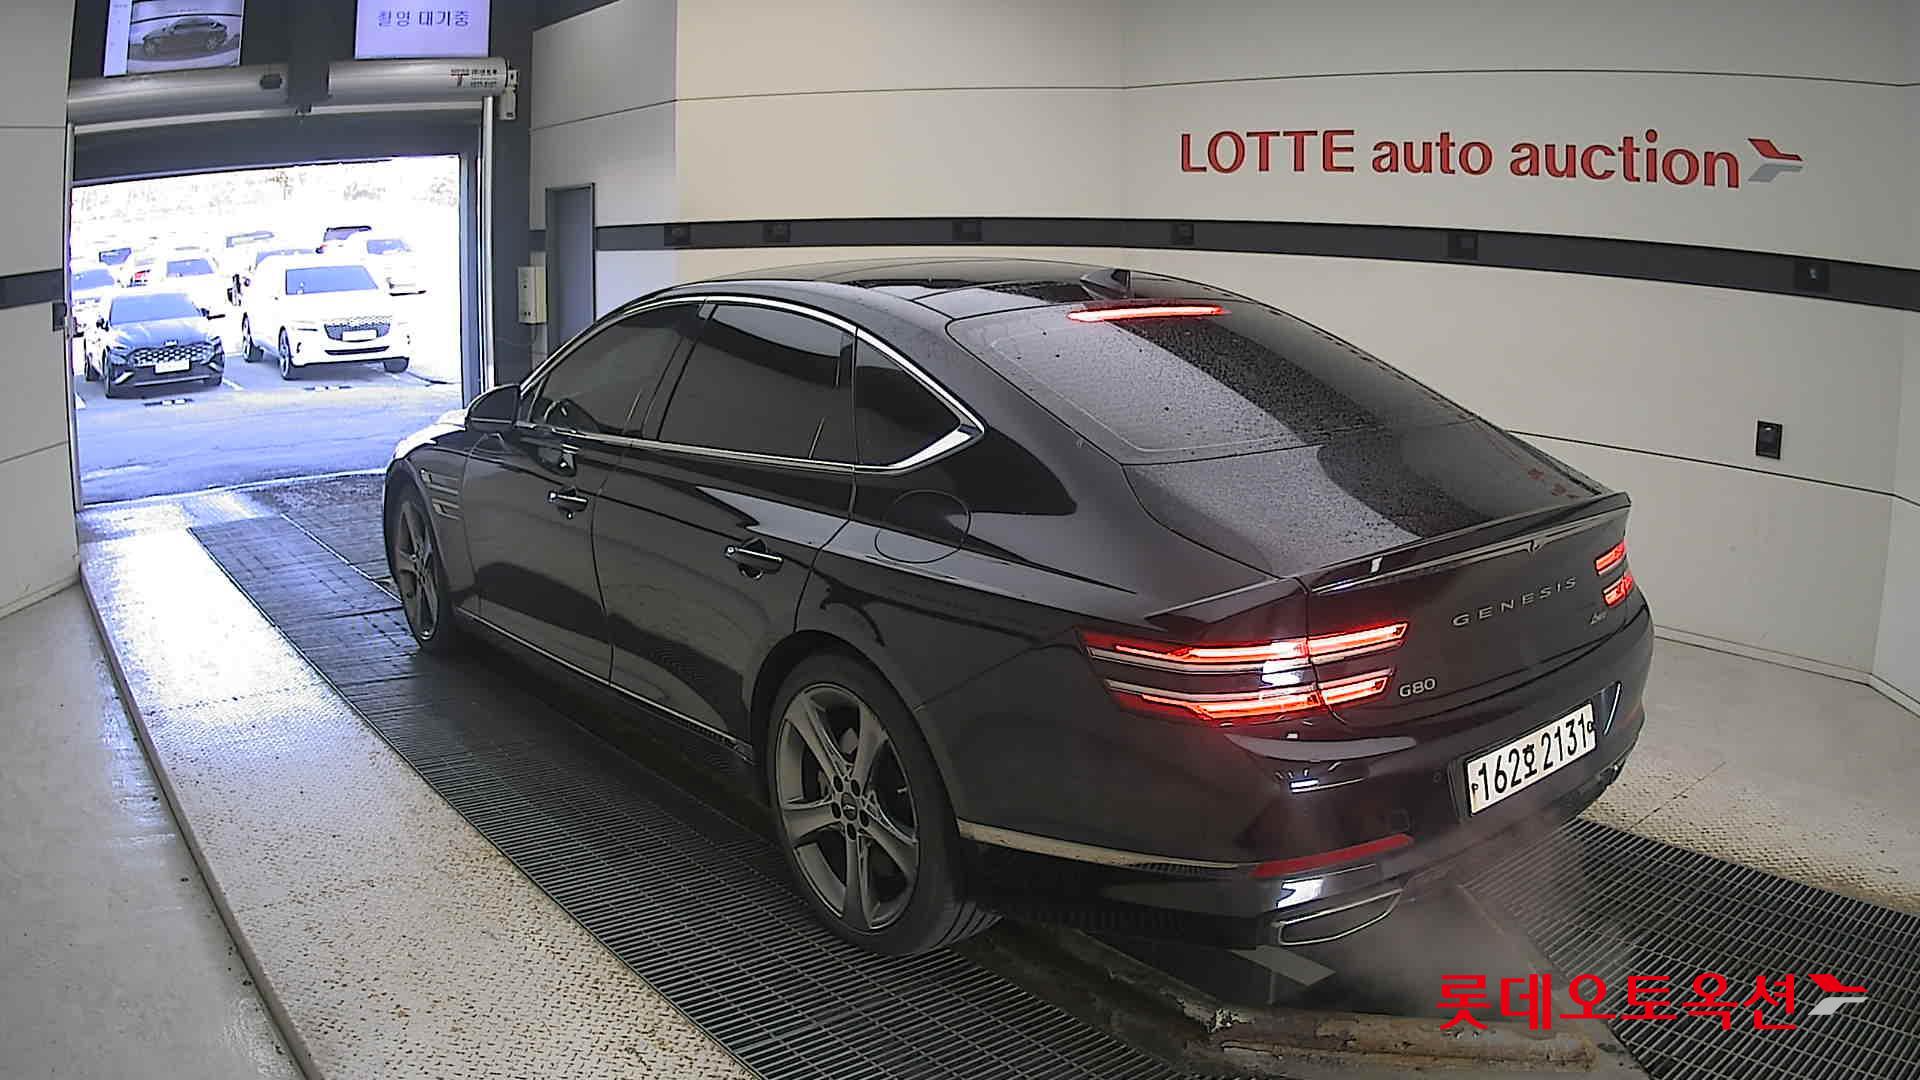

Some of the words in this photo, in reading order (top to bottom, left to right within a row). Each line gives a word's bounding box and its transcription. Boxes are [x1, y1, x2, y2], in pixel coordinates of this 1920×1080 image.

[1181, 129, 1355, 173] LOTTE
[1371, 132, 1493, 175] auto
[1509, 129, 1740, 189] auction
[1452, 576, 1577, 627] GENESIS
[1398, 677, 1437, 698] G80
